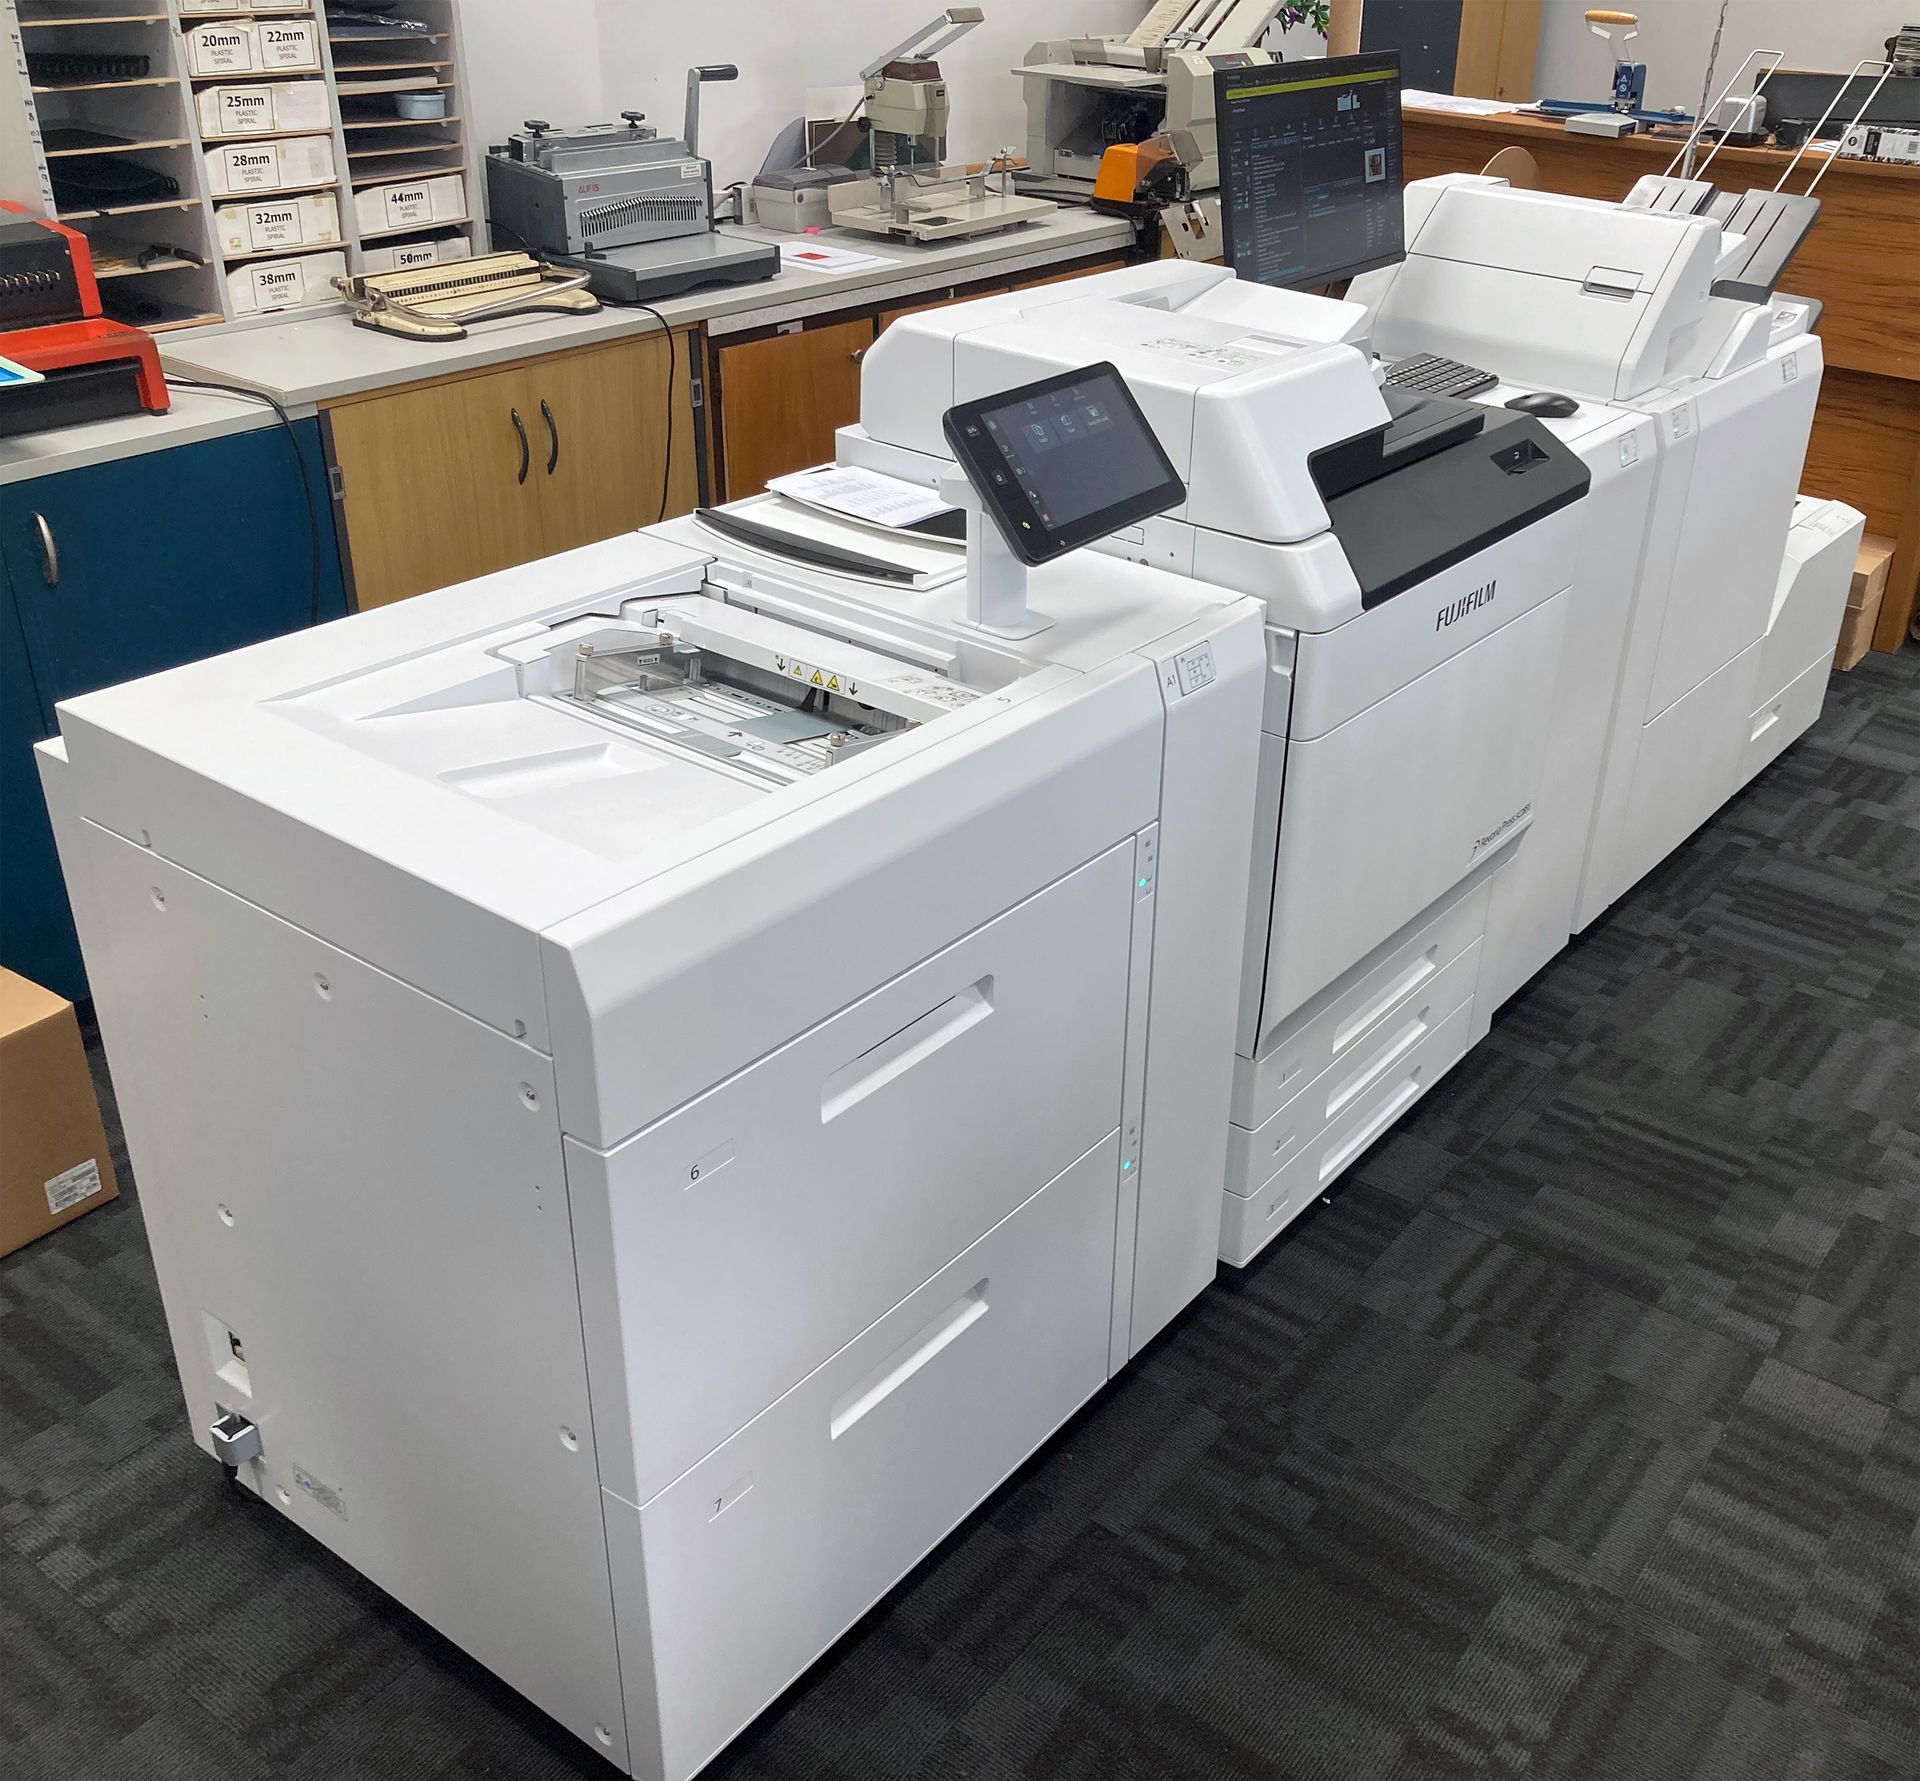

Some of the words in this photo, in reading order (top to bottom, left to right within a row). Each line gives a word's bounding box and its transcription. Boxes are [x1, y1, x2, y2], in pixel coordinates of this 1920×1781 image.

[201, 35, 240, 47] 20mm
[266, 31, 304, 42] 22mm
[211, 49, 233, 57] PLASTIC
[227, 96, 264, 107] 25mm
[232, 155, 270, 167] 28mm
[391, 191, 423, 204] 44mm
[255, 212, 292, 225] 32mm
[400, 252, 432, 265] 50mm
[259, 272, 296, 286] 38mm
[1436, 580, 1496, 632] FUJIFILM
[690, 1164, 700, 1180] 6
[714, 1497, 722, 1512] 7
